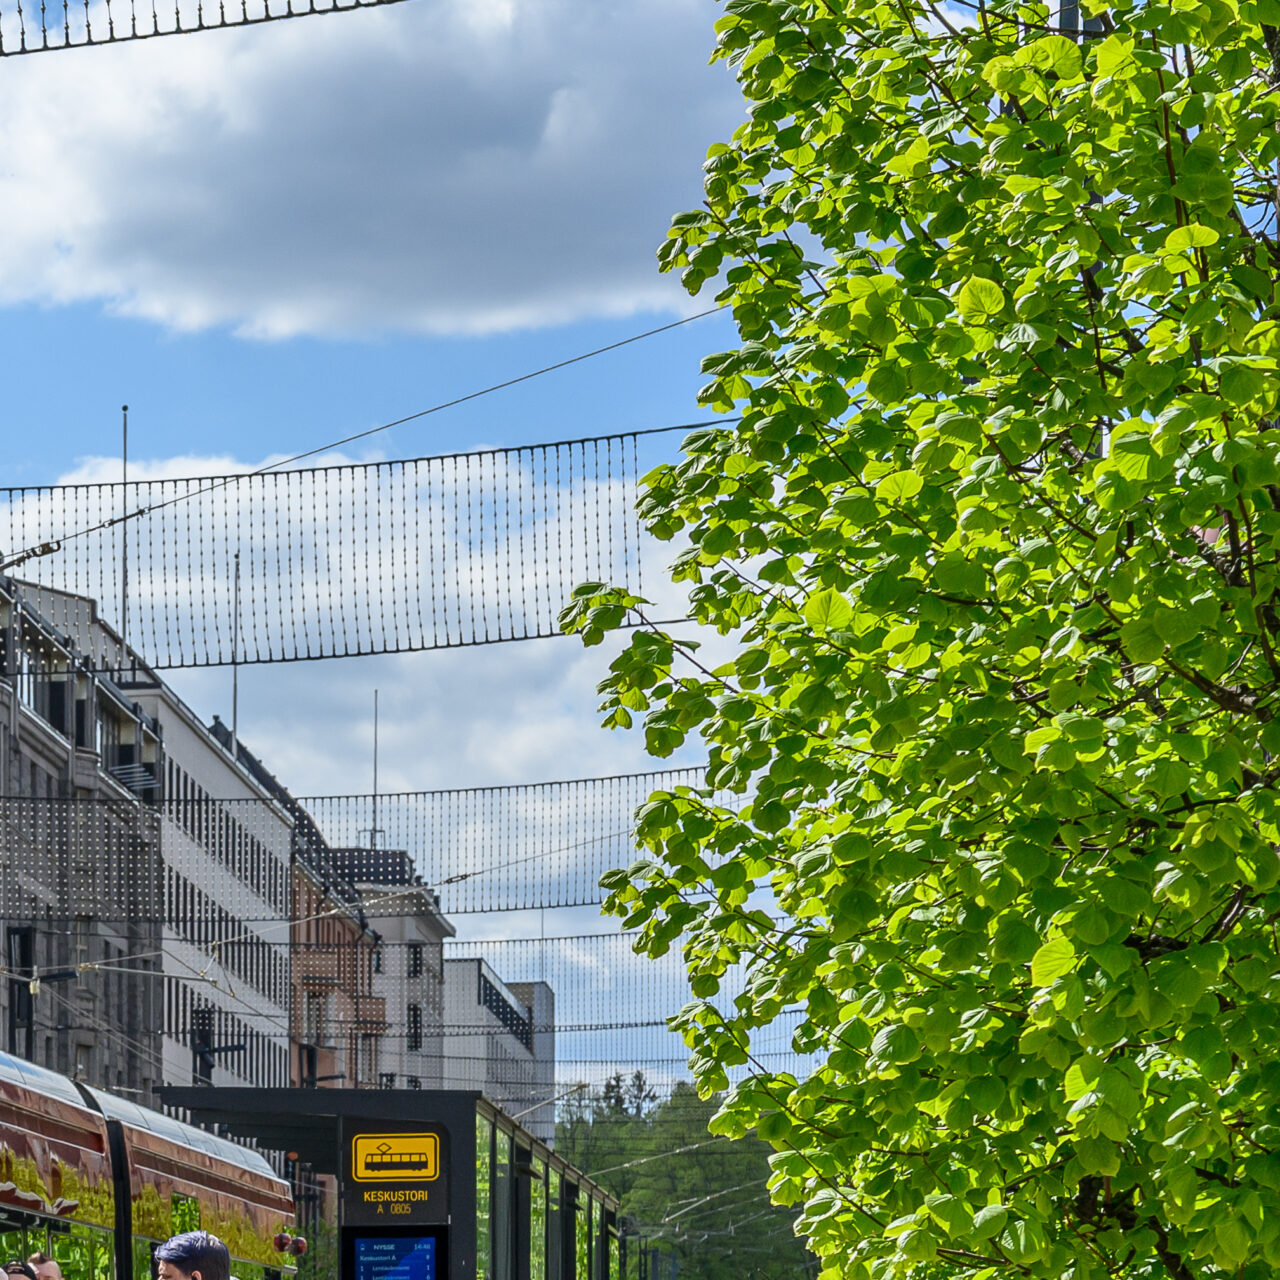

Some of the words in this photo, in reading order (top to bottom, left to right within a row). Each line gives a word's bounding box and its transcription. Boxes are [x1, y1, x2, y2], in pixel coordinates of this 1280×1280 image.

[363, 1190, 429, 1202] KESKUSTORI
[376, 1204, 384, 1214] A
[390, 1203, 412, 1215] 0805
